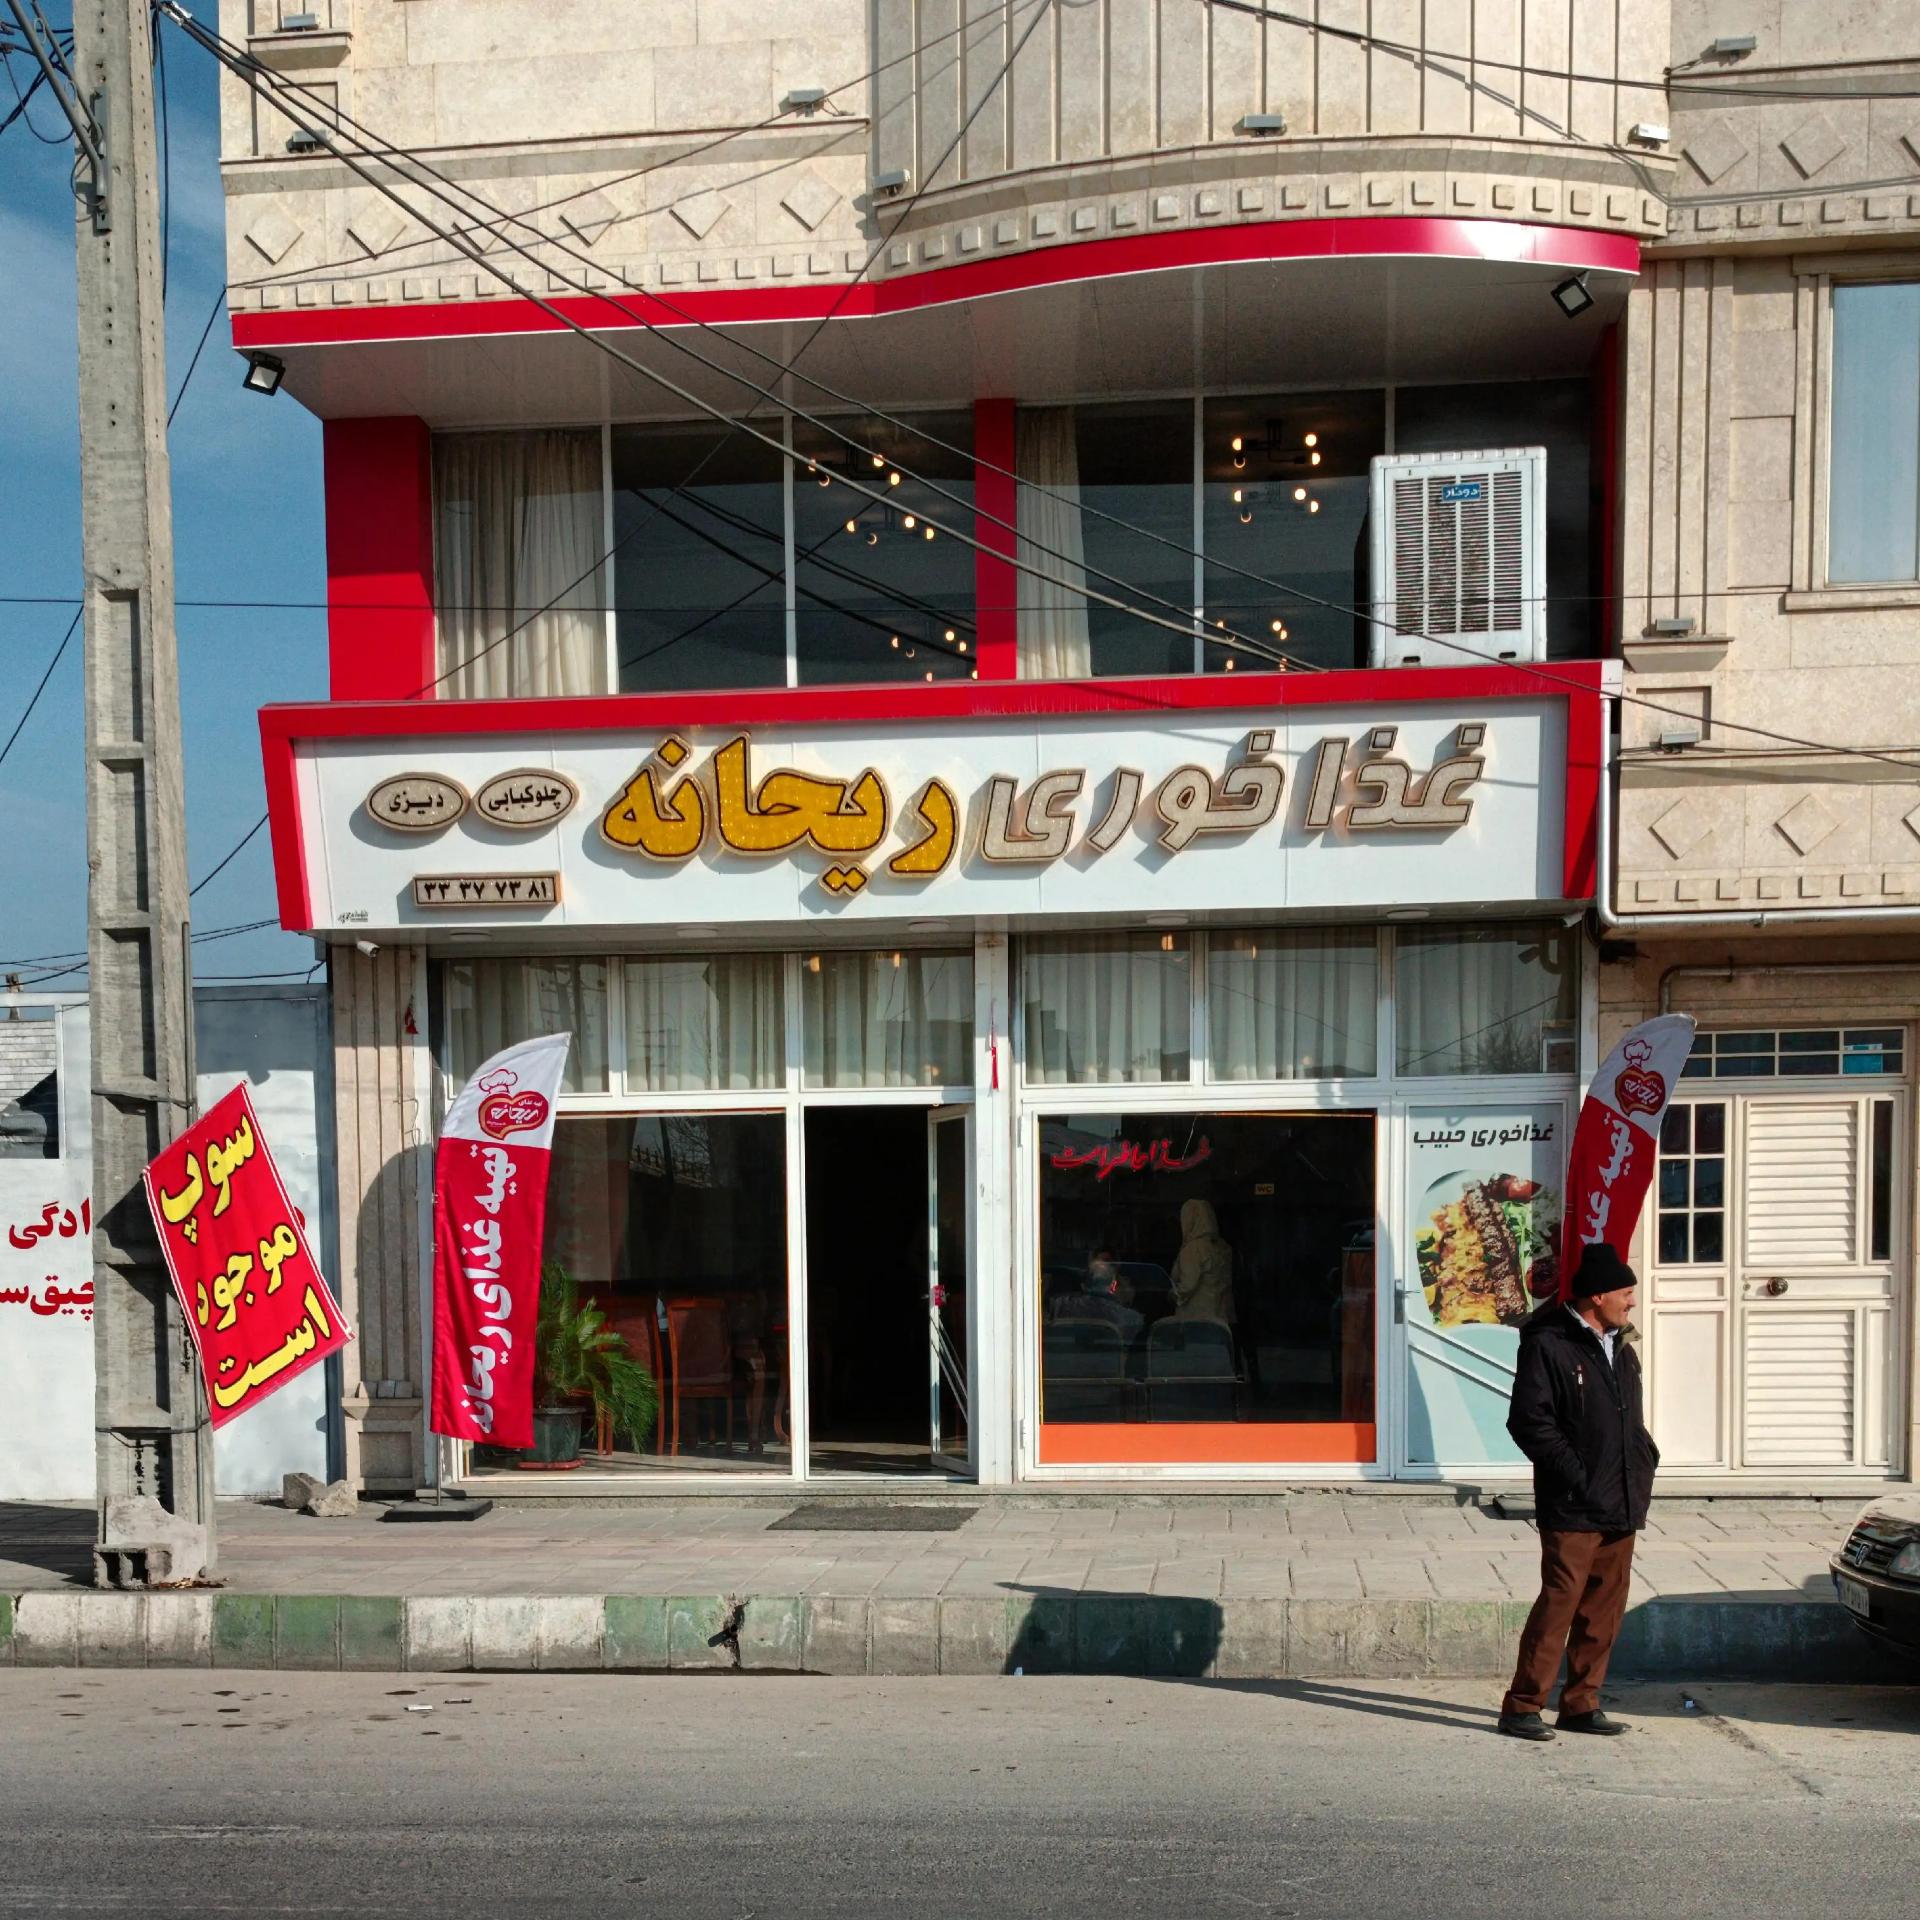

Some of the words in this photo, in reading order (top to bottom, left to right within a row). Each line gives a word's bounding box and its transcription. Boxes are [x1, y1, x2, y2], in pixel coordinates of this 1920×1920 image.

[389, 790, 444, 815] دیزی
[488, 784, 562, 812] چلوکبابی
[601, 731, 958, 897] ریحانه
[160, 1114, 256, 1245] سوپ
[470, 1144, 518, 1213] تهیه
[1413, 1129, 1466, 1149] حبیب
[1598, 1111, 1634, 1189] تهیه
[197, 1222, 298, 1331] موجود
[461, 1219, 512, 1321] غذای
[213, 1284, 331, 1408] است
[459, 1325, 512, 1435] ریحانه
